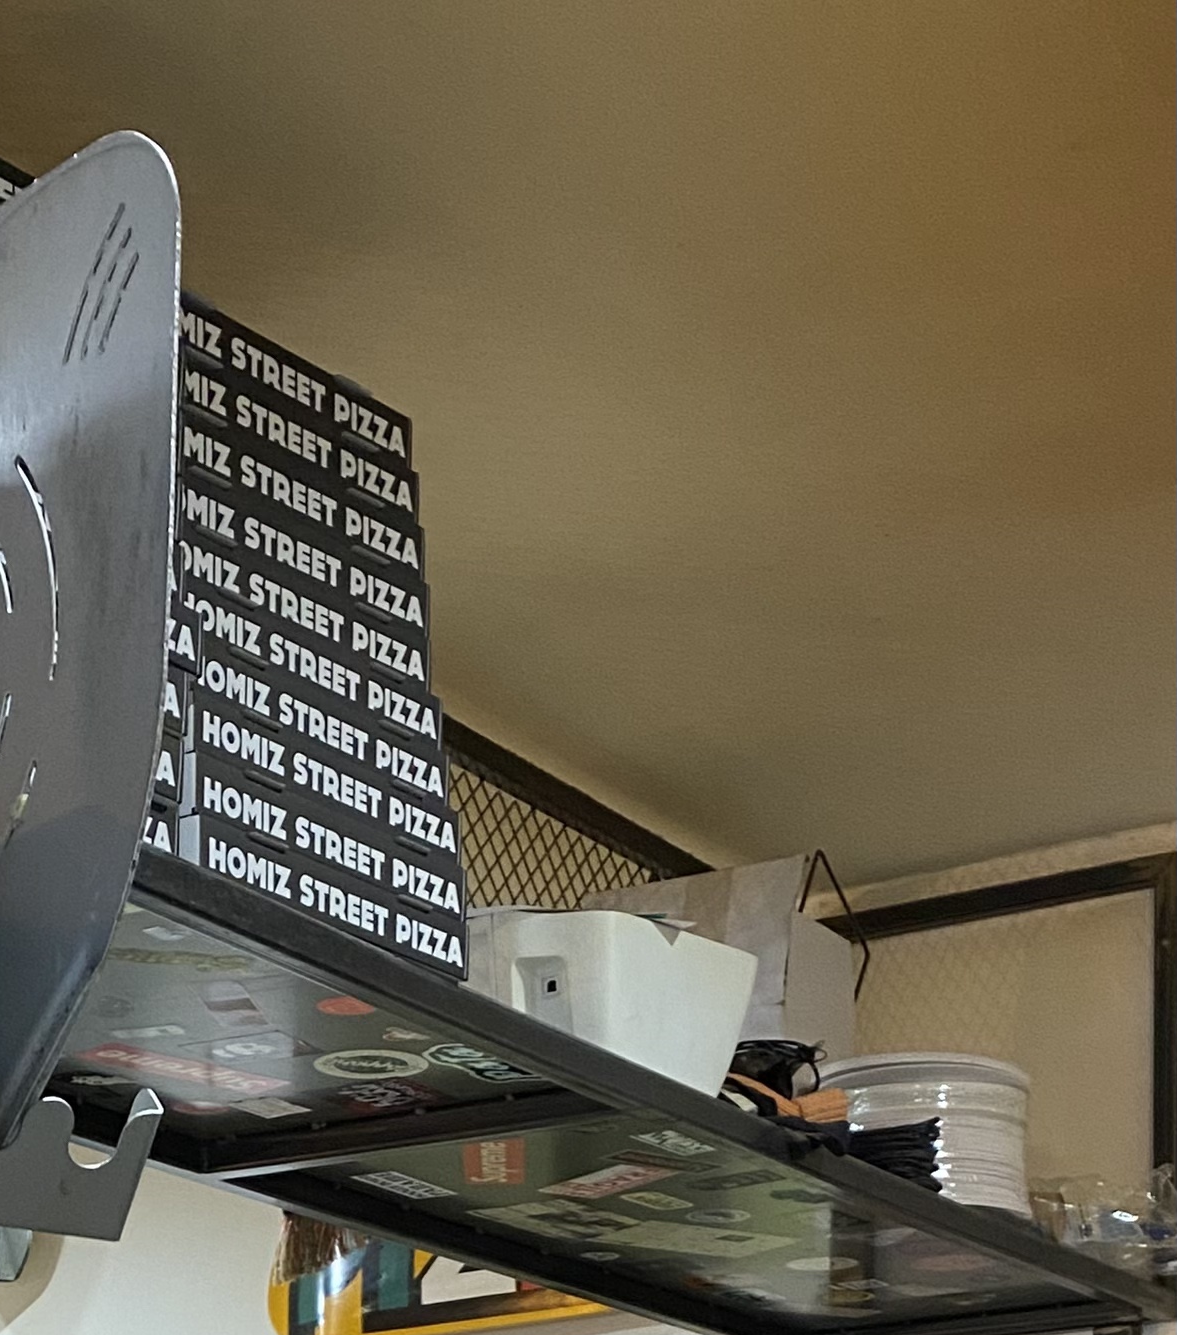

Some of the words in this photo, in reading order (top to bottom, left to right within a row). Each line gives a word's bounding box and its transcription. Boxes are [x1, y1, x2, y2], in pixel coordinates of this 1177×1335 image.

[179, 311, 221, 357] MIZ
[232, 338, 325, 411] STREET
[335, 394, 405, 457] PIZZA
[186, 370, 226, 416] MIZ
[237, 396, 331, 468] STREET
[341, 450, 412, 511] PIZZA
[182, 485, 234, 539] MIZ
[245, 517, 341, 586] STREET
[350, 567, 423, 627] PIZZA
[184, 427, 230, 476] MIZ
[241, 456, 337, 526] STREET
[346, 508, 418, 569] PIZZA
[179, 541, 239, 594] OMIZ
[250, 574, 344, 642] STREET
[353, 622, 424, 681] PIZZA
[270, 634, 360, 701] STREET
[368, 681, 436, 739] PIZZA
[279, 694, 368, 760] STREET
[376, 739, 448, 797] PIZZA
[203, 711, 285, 776] HOMIZ
[294, 753, 382, 818] STREET
[389, 797, 456, 853] PIZZA
[204, 777, 287, 840] HOMIZ
[295, 817, 385, 880] STREET
[393, 859, 465, 913] PIZZA
[209, 837, 291, 899] HOMIZ
[300, 875, 388, 936] STREET
[396, 914, 467, 967] PIZZA
